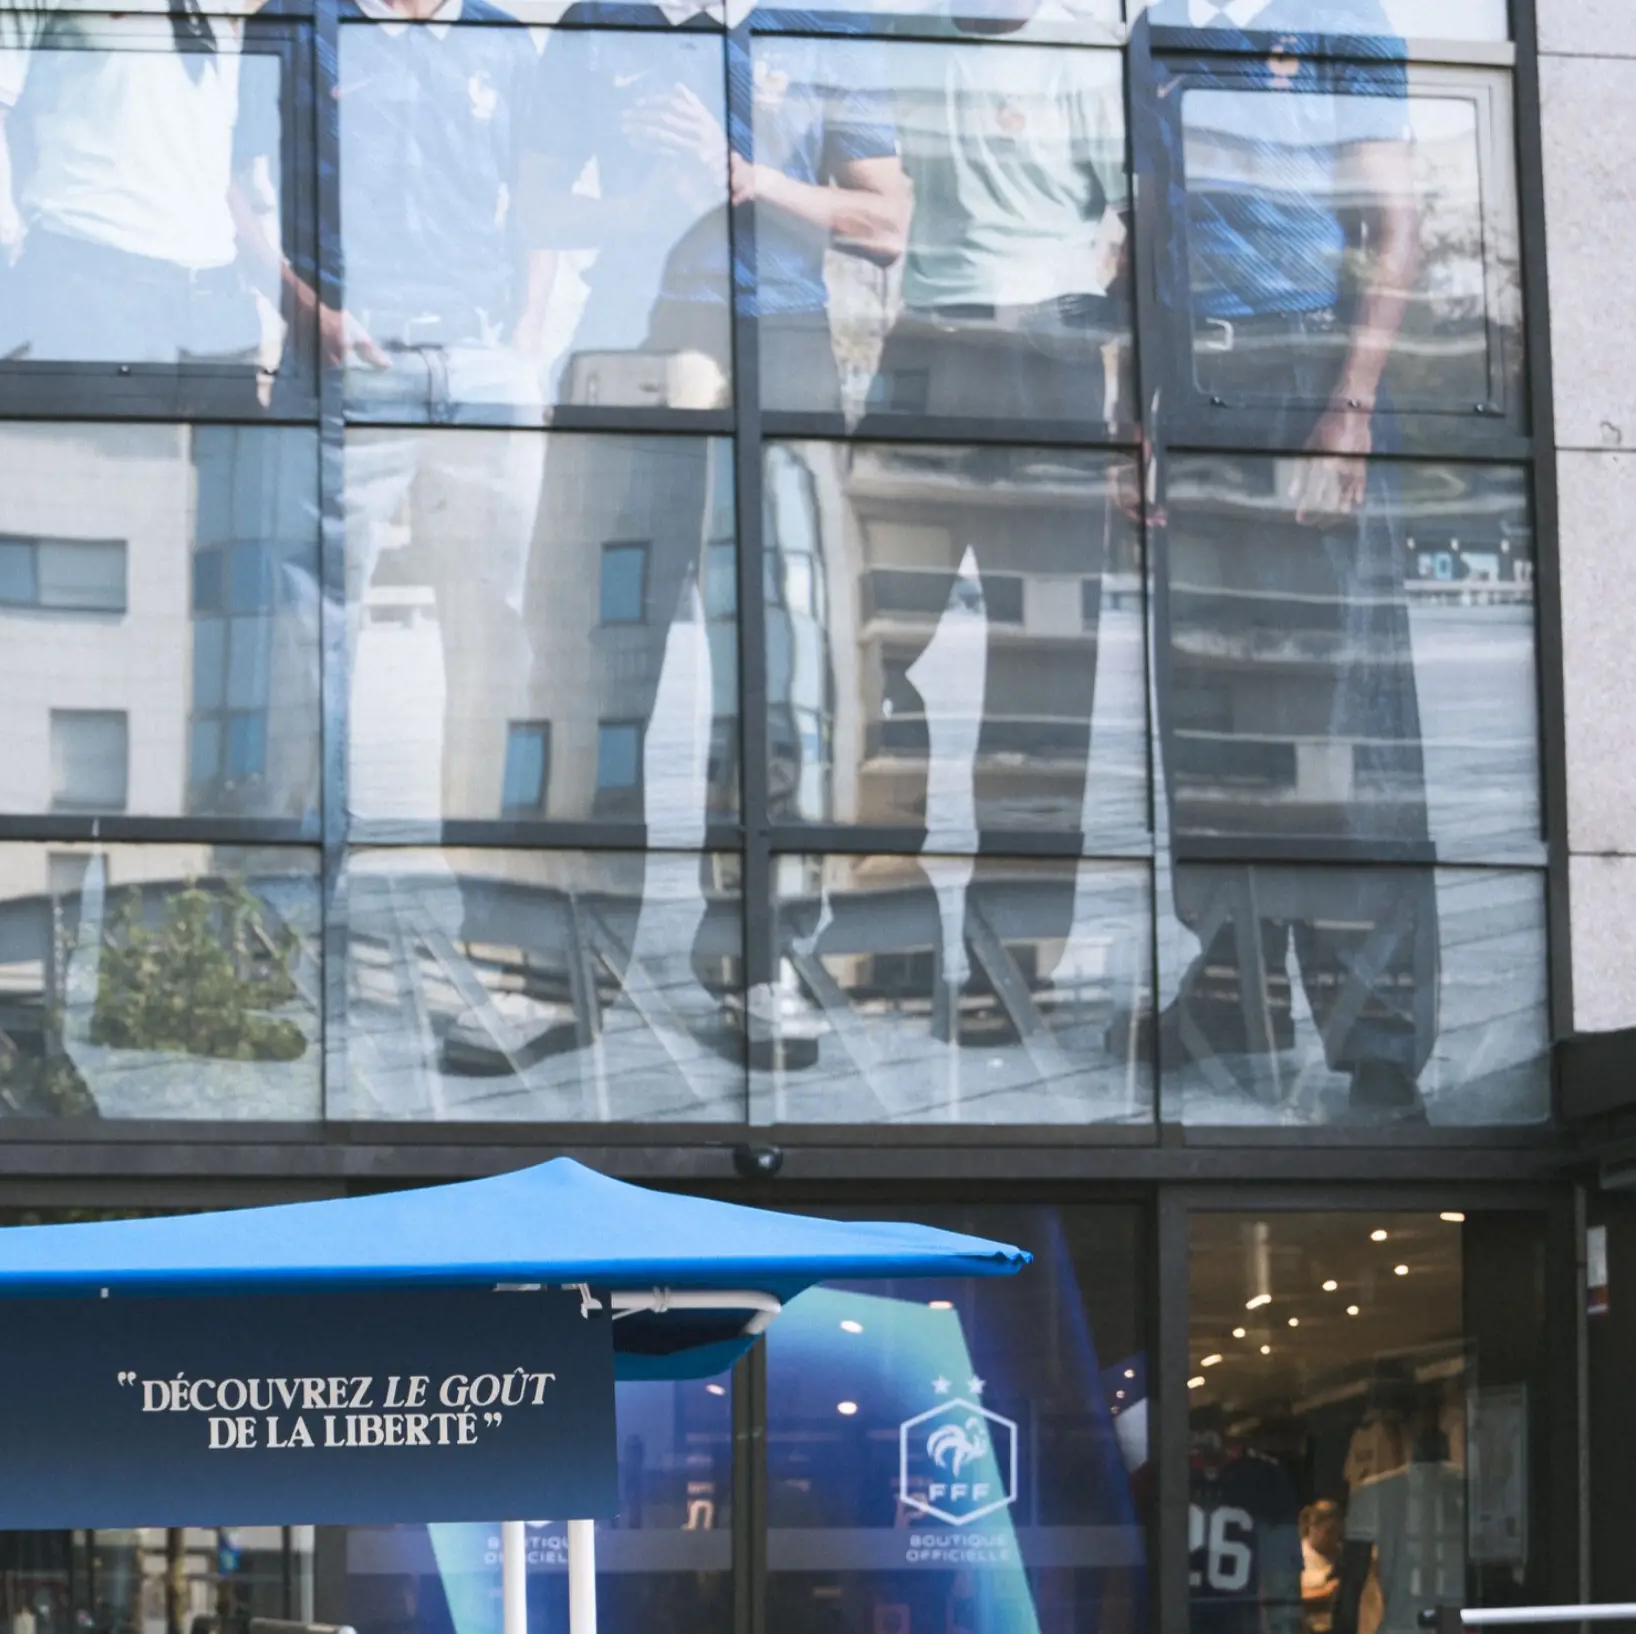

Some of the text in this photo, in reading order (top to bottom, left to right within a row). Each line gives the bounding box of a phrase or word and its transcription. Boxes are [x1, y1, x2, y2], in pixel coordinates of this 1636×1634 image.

[383, 1376, 430, 1407] LE
[439, 1367, 556, 1406] GOÛT
[208, 1417, 257, 1449] DE
[266, 1415, 315, 1448] LA
[929, 1483, 990, 1501] FFF
[910, 1535, 1007, 1548] BOUTIQUE
[906, 1550, 1010, 1563] OFFICIELLE
